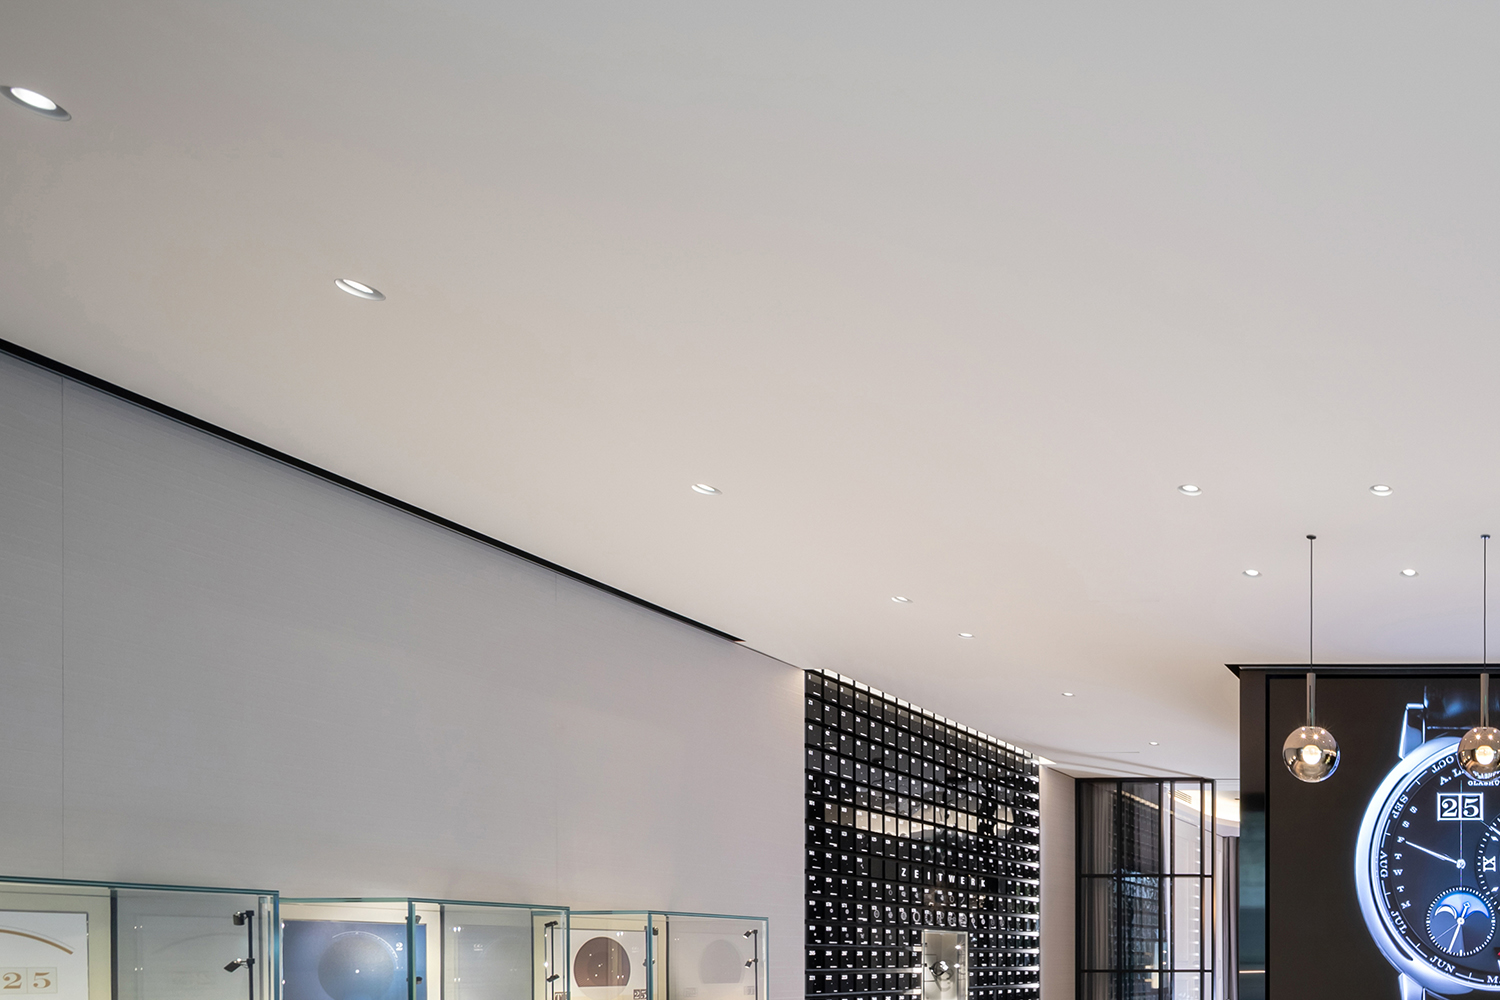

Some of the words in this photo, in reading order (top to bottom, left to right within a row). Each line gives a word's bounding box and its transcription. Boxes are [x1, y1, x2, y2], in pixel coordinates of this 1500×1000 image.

[1431, 754, 1455, 774] OCT
[1392, 794, 1409, 819] SEP
[1409, 805, 1418, 814] S
[1441, 797, 1479, 817] 25
[1402, 820, 1410, 828] S
[1397, 835, 1405, 844] F
[1379, 851, 1389, 878] AUG
[1393, 868, 1403, 876] W
[1397, 885, 1405, 893] T
[1401, 900, 1412, 909] M
[1390, 910, 1408, 934] JUL
[1429, 955, 1456, 974] JUN
[2, 971, 52, 990] 25
